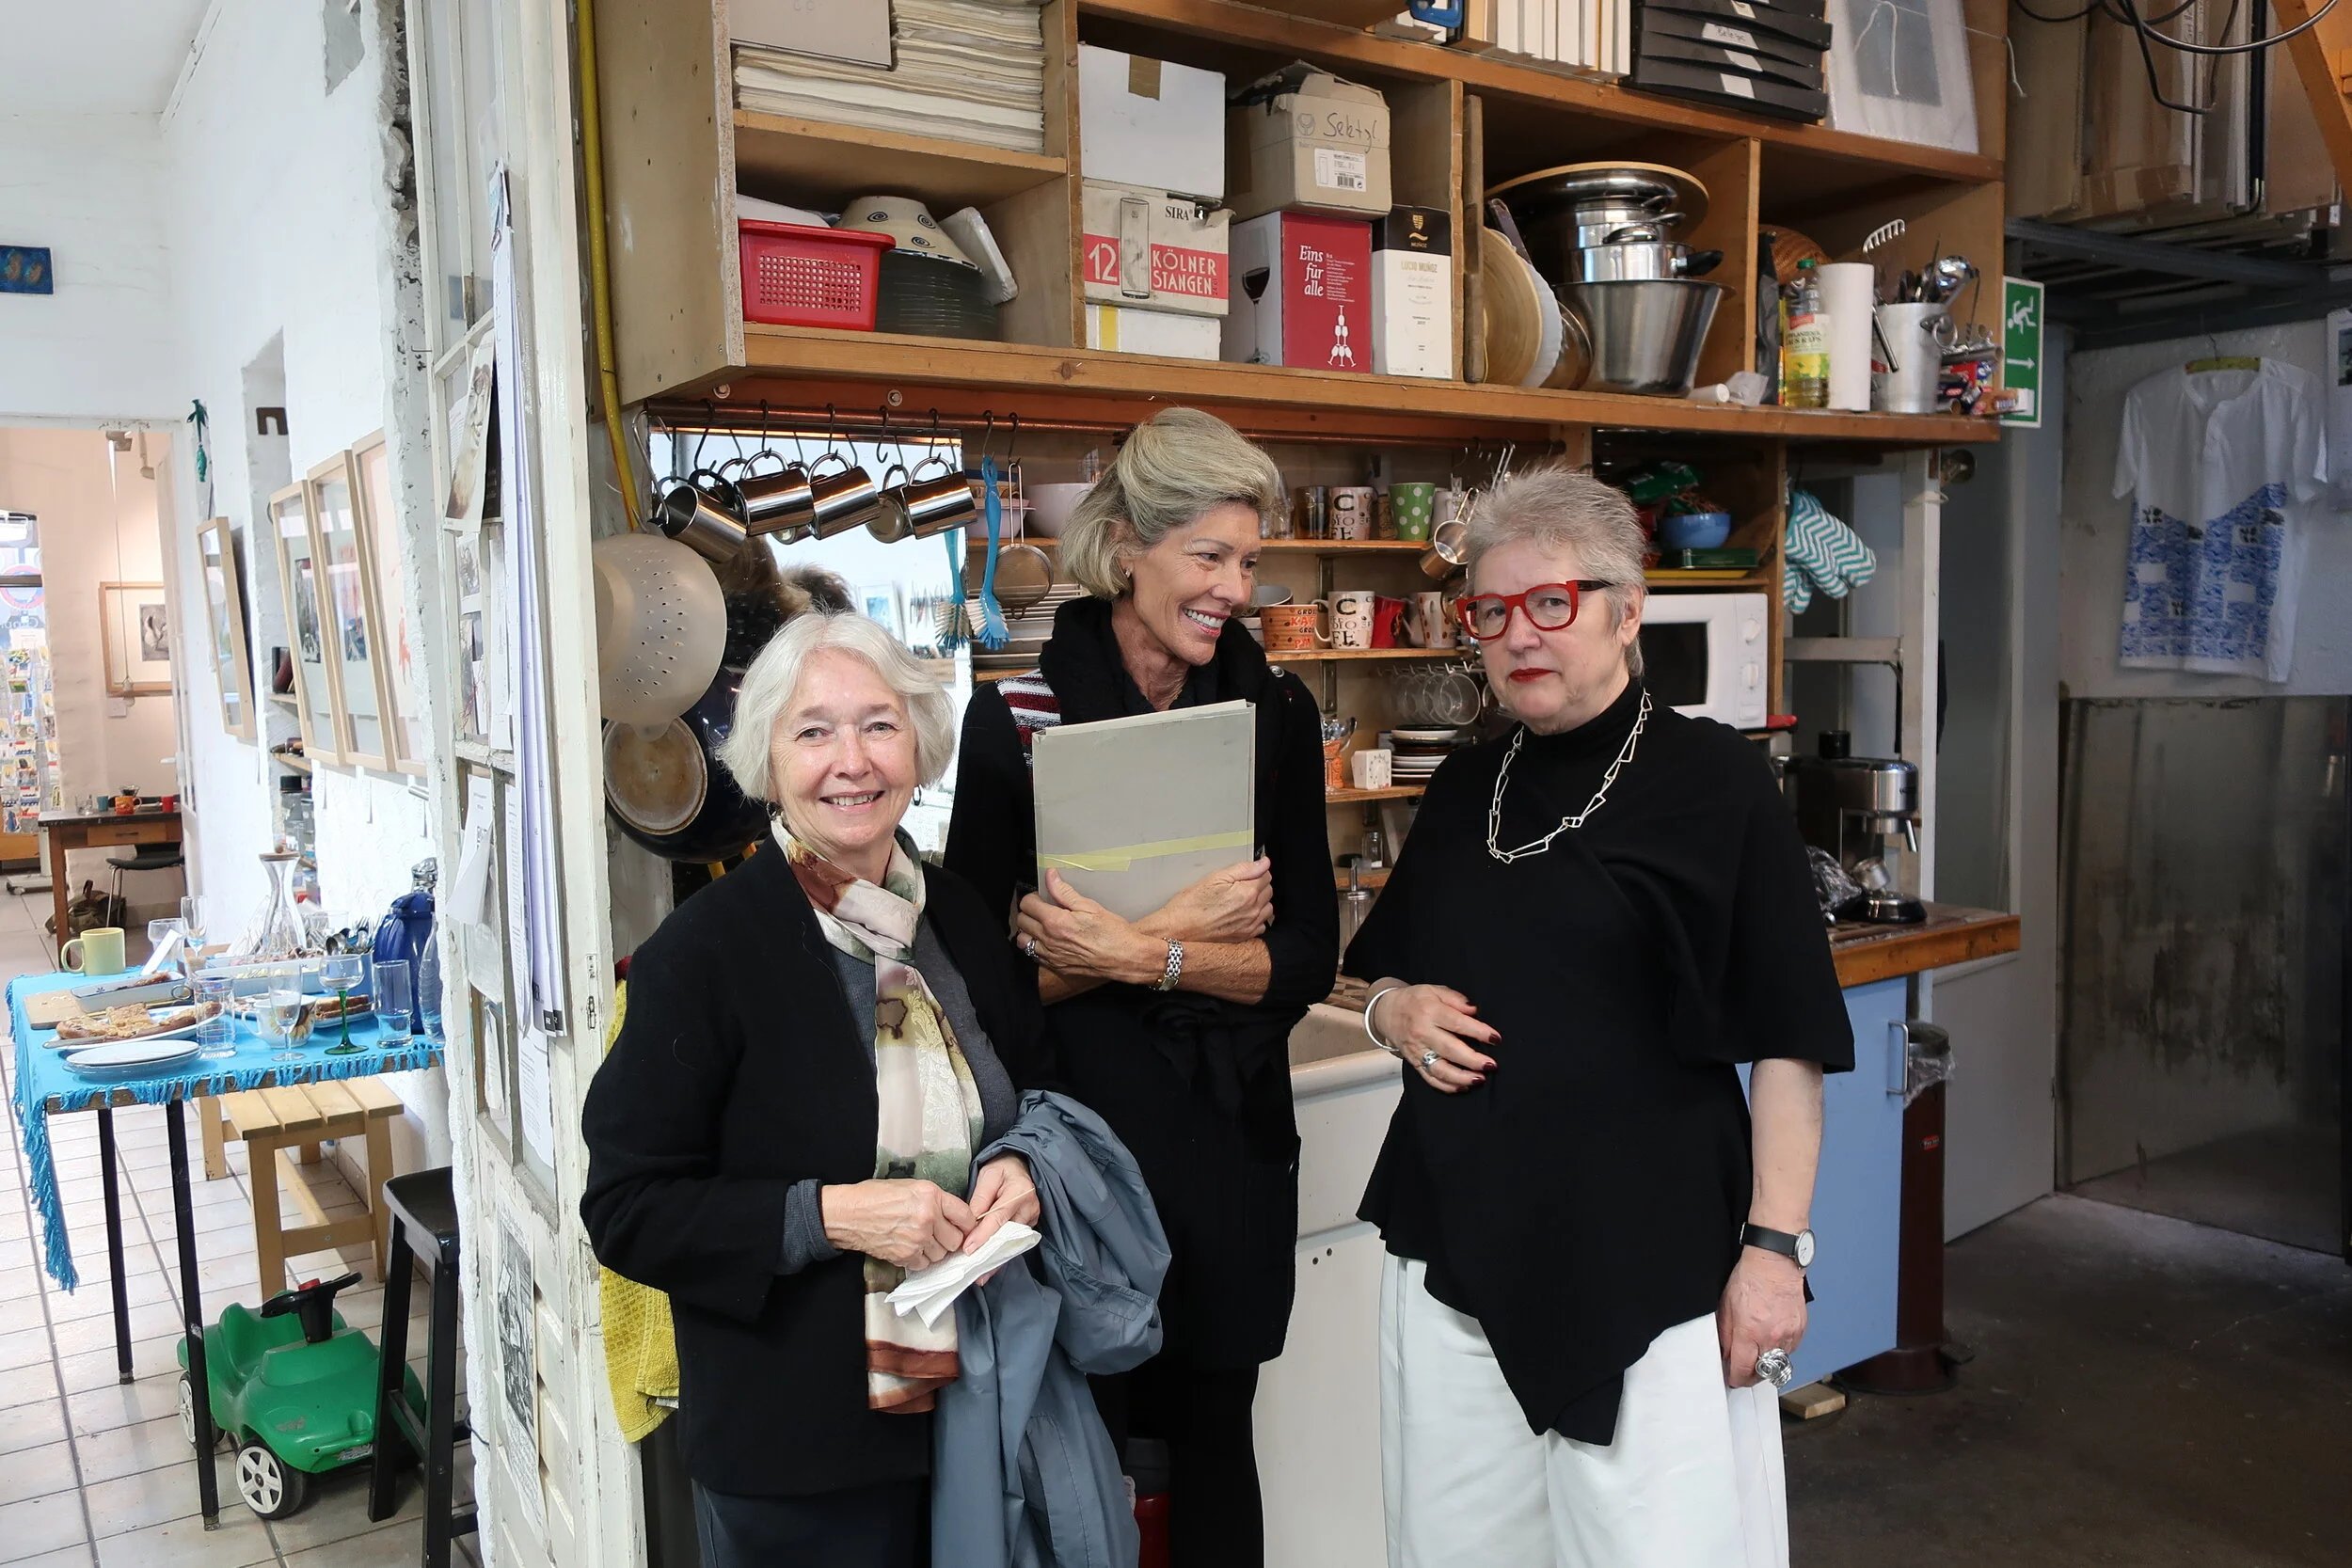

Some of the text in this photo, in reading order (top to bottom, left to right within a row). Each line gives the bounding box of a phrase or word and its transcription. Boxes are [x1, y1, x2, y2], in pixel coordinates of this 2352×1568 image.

[1088, 243, 1118, 282] 12
[1152, 248, 1217, 276] KÖLNER
[1299, 245, 1324, 262] Eins
[1152, 270, 1213, 295] STANGEN
[1305, 262, 1324, 281] für
[1304, 280, 1324, 296] alle
